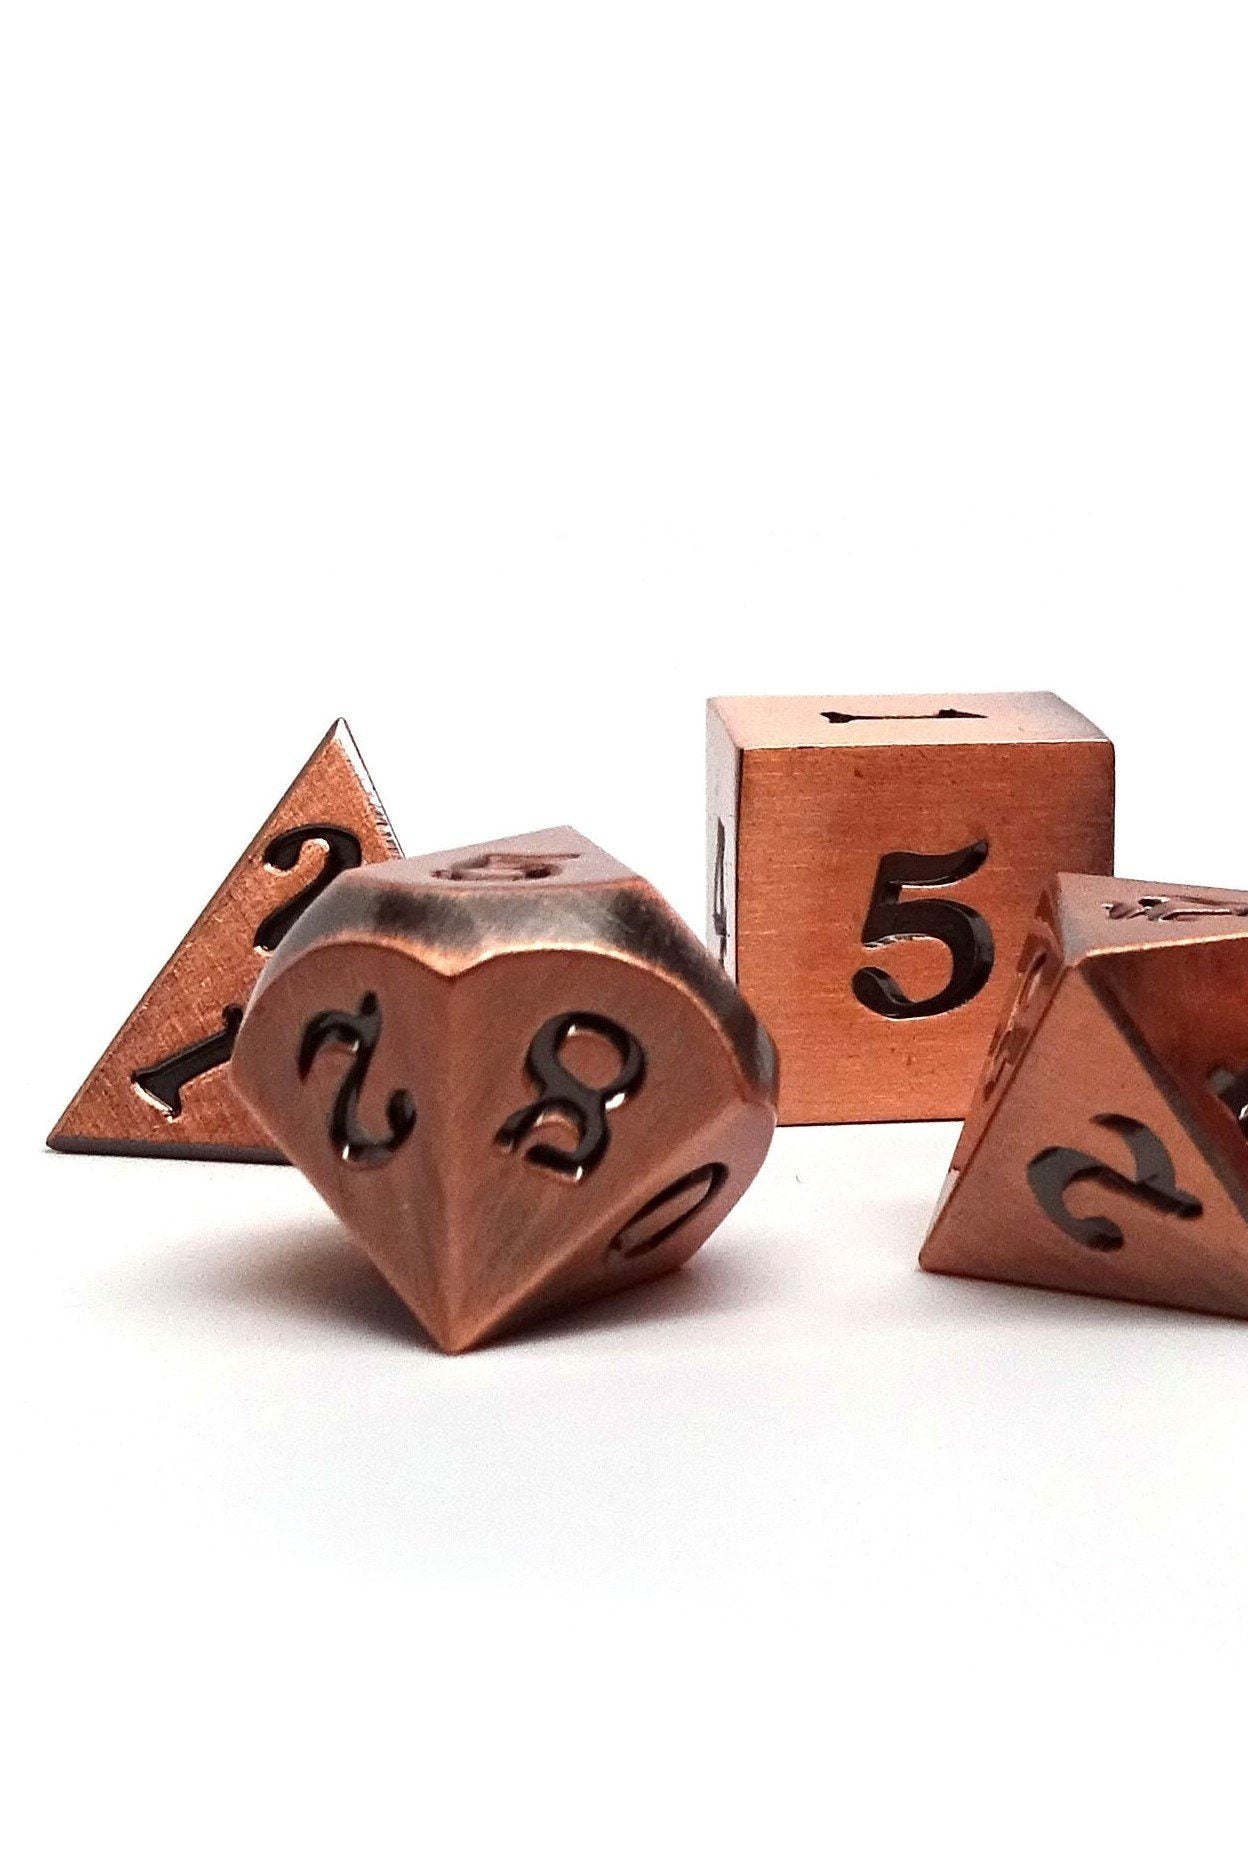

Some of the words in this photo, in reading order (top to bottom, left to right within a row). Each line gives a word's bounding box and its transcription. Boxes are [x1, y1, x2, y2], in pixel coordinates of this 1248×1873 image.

[820, 708, 988, 725] 1
[254, 823, 362, 956] 2
[851, 839, 995, 1021] 5
[131, 1004, 244, 1121] 1
[299, 990, 417, 1168] 2
[494, 1012, 648, 1183] 8
[606, 1162, 729, 1260] 0
[1025, 1111, 1203, 1251] 2
